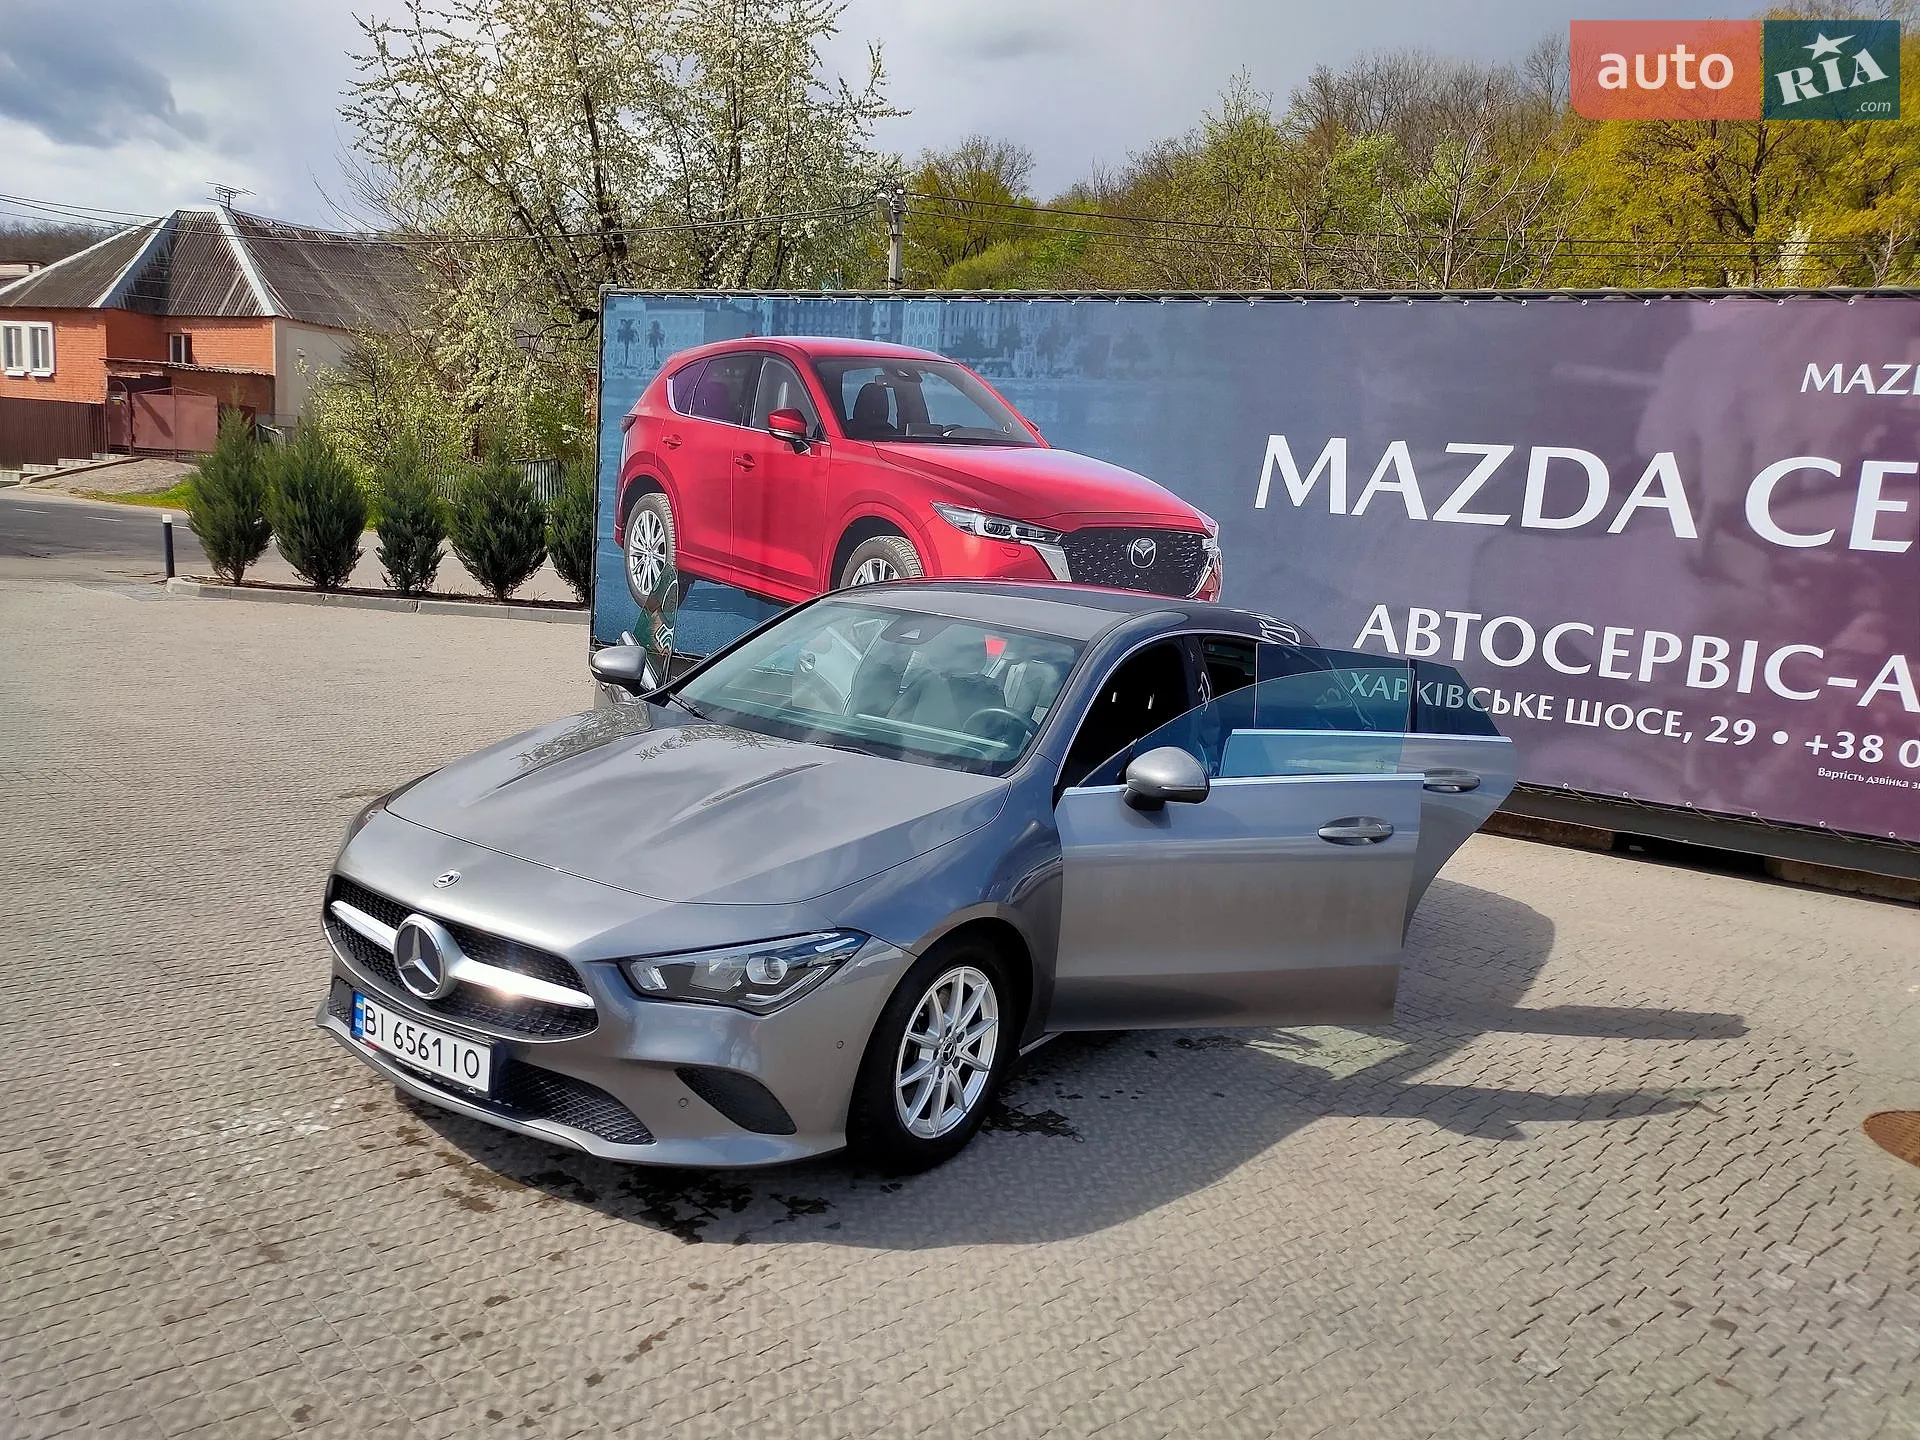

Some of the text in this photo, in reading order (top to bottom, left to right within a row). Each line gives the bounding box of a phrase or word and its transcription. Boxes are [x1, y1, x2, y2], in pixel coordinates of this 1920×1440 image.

[1800, 363, 1920, 395] MAZ
[1254, 434, 1919, 553] MAZDA CE
[1352, 604, 1920, 713] АВТОСЕРВІС-А
[1349, 672, 1554, 721] ХАРКІВСЬКЕ
[1564, 698, 1694, 743] ШОСЕ,
[1704, 716, 1757, 745] 29
[1804, 731, 1884, 763] +38
[1817, 767, 1864, 782] Вартість
[1866, 776, 1909, 788] дзвінка
[364, 1004, 384, 1042] BI
[393, 1021, 442, 1067] 6561
